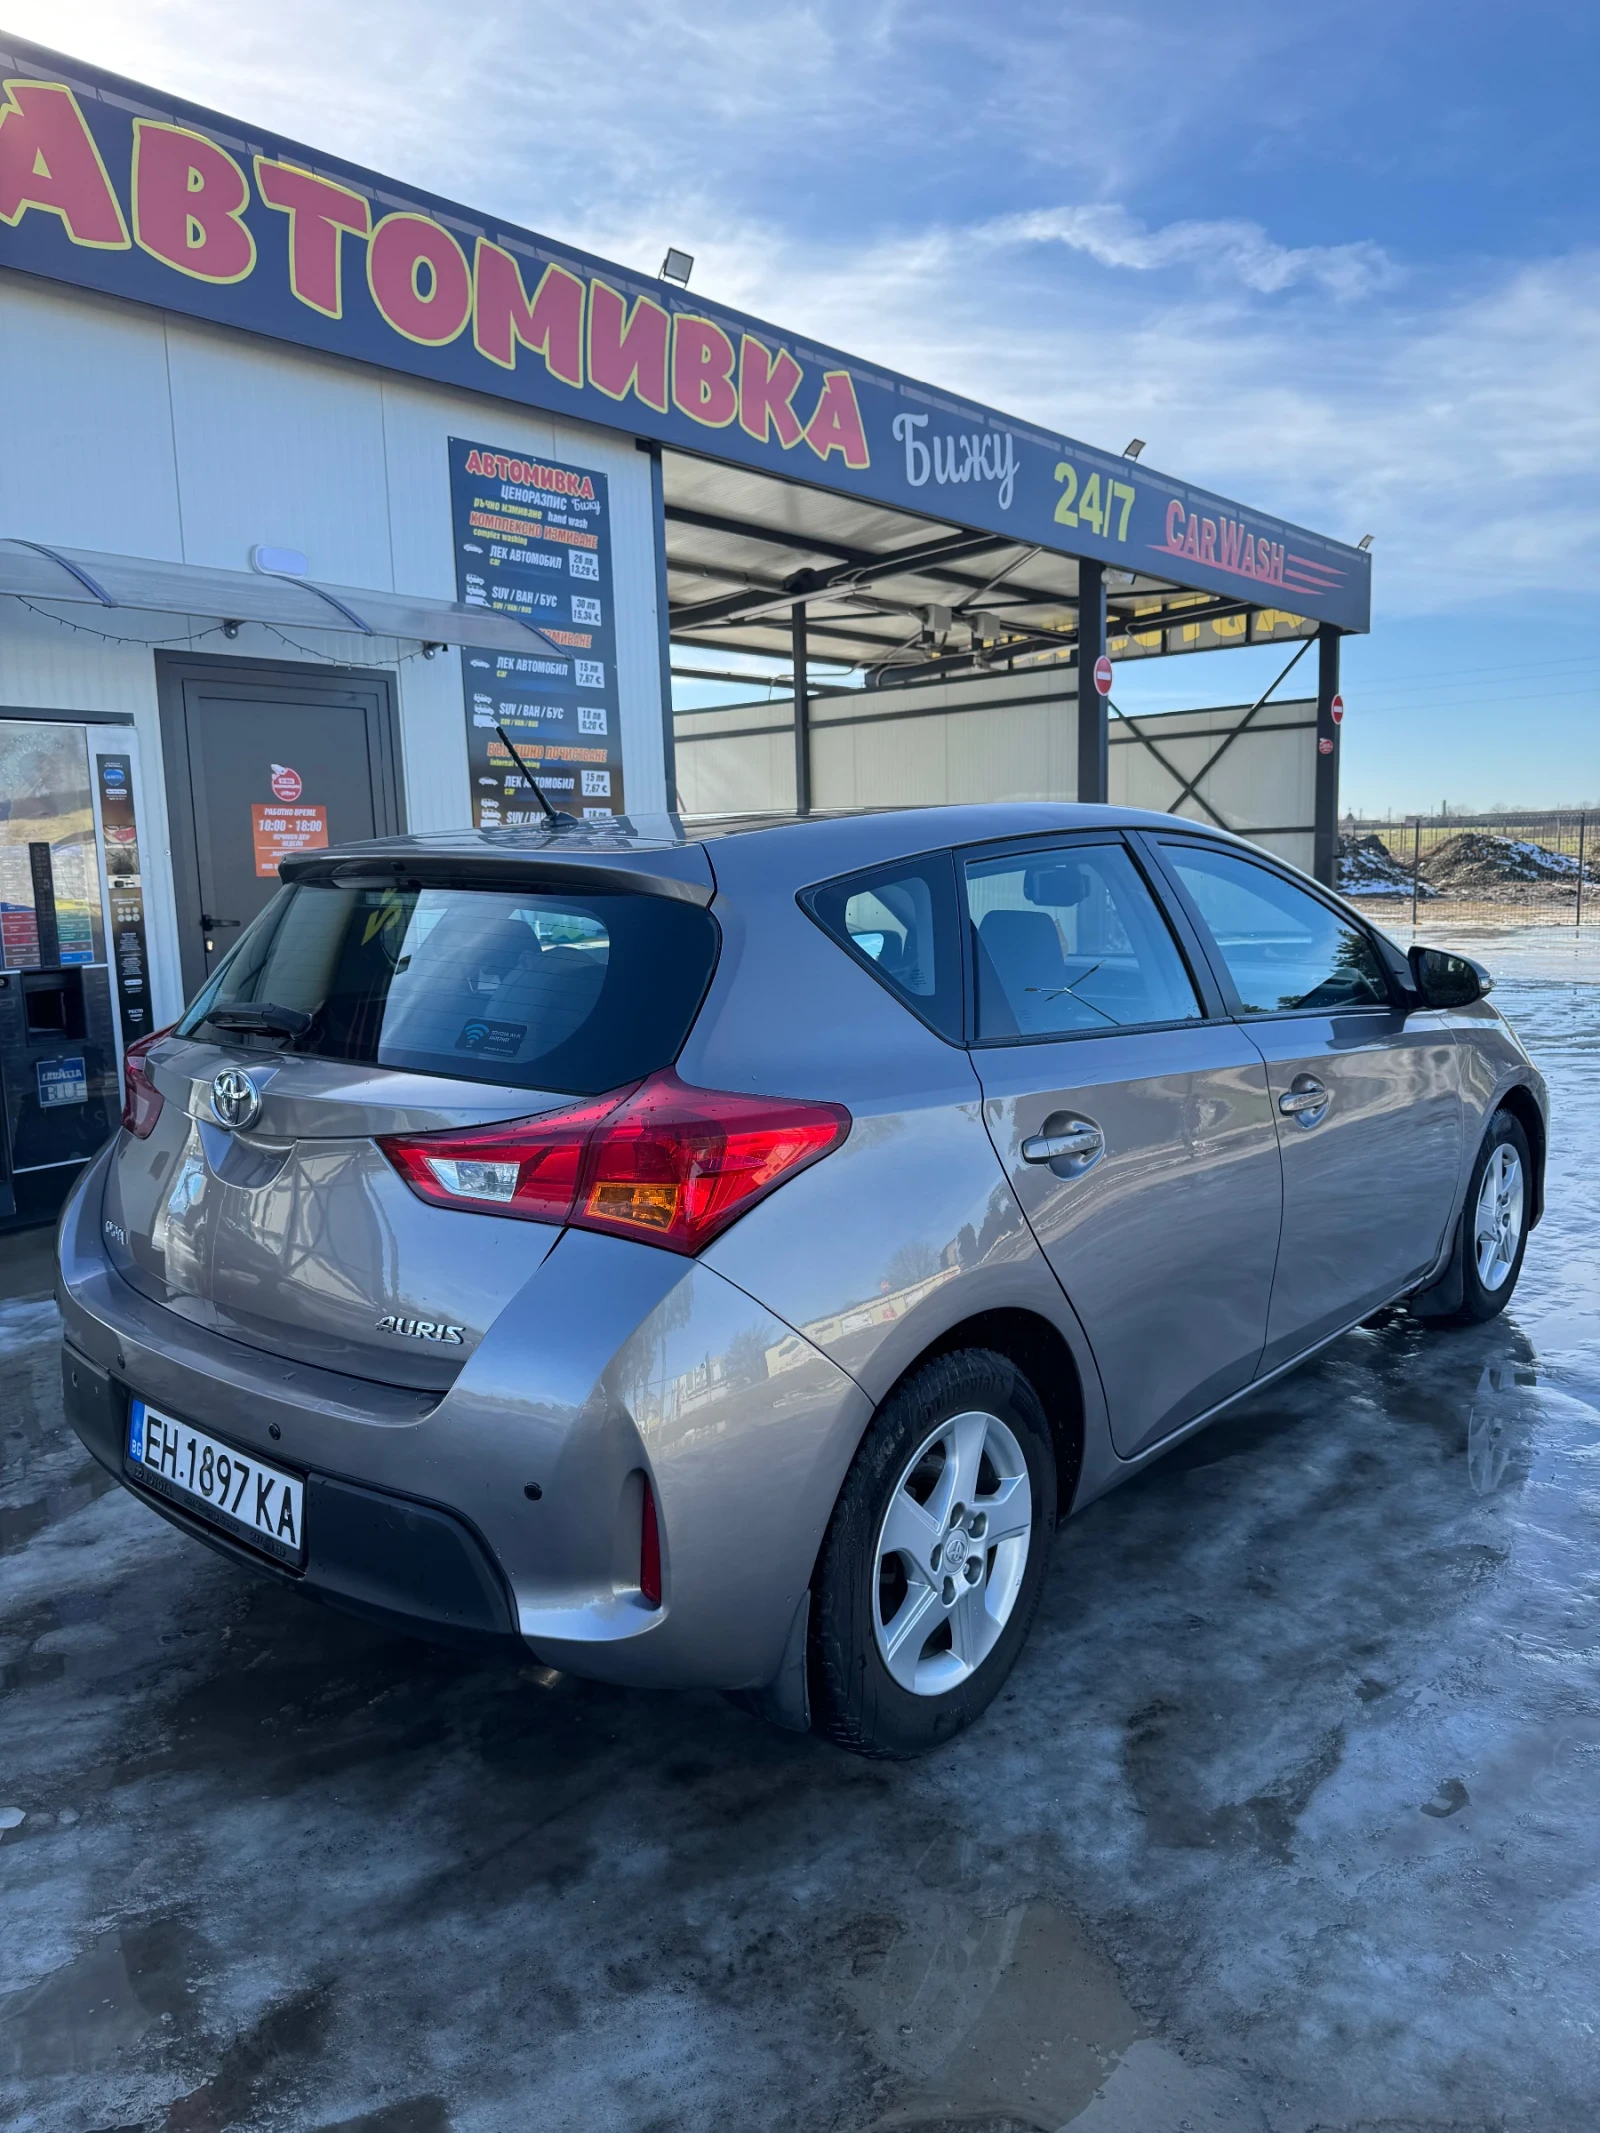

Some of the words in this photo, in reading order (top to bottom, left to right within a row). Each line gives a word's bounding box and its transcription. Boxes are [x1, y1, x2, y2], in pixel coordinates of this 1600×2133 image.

[0, 79, 871, 469] АВТОМИВКА
[892, 412, 1020, 510] Бижу
[466, 450, 595, 500] АВТОМИВКА
[473, 497, 500, 511] ръчно
[501, 502, 542, 520] измиване
[501, 485, 567, 511] ЦЕНОРАЗПИС
[571, 499, 601, 515] Бижу
[1053, 462, 1136, 543] 24/7
[470, 511, 542, 539] КОМПЛЕКСНО
[543, 526, 598, 549] ИЗМИВАНЕ
[547, 511, 567, 526] hand
[568, 516, 588, 529] wash
[489, 544, 507, 559] ЛЕК
[509, 549, 562, 569] АВТОМОБИЛ
[491, 586, 510, 601] SUV
[516, 589, 533, 605] ВАН
[540, 594, 558, 608] БУС
[496, 656, 515, 670] ЛЕК
[515, 658, 568, 676] АВТОМОБИЛ
[579, 663, 589, 672] 15
[499, 702, 517, 716] SUV
[523, 705, 540, 718] ВАН
[546, 706, 564, 720] БУС
[545, 745, 608, 764] ПОЧИСТВАНЕ
[504, 775, 522, 788] ЛЕК
[259, 819, 286, 832] 10:00
[296, 820, 322, 832] 18:00
[374, 1315, 466, 1345] AURIS
